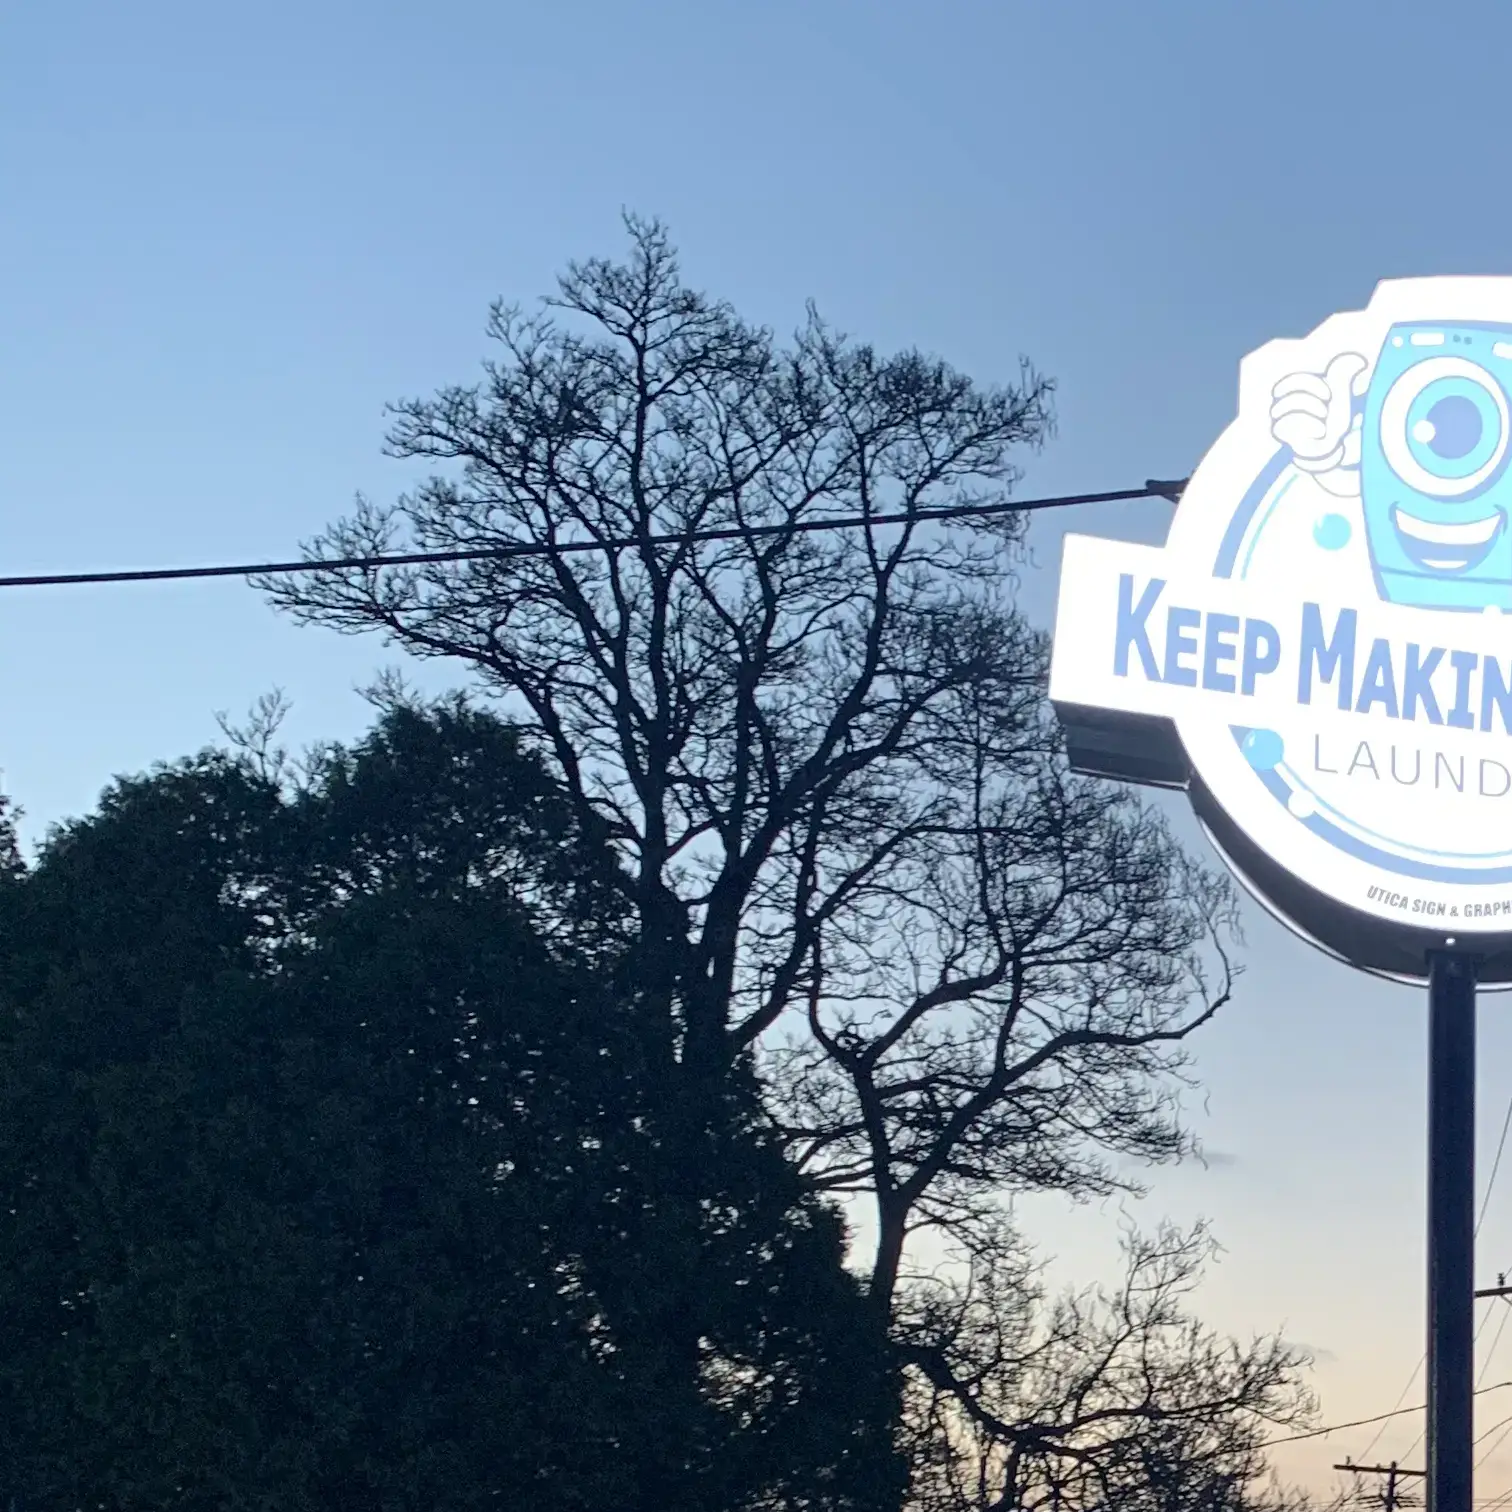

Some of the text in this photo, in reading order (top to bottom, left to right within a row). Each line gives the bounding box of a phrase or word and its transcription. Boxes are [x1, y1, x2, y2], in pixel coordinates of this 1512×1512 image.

[1113, 573, 1281, 697] KEEP
[1366, 885, 1409, 911] UTICA
[1411, 898, 1447, 917] SIGN
[1449, 905, 1460, 918] &
